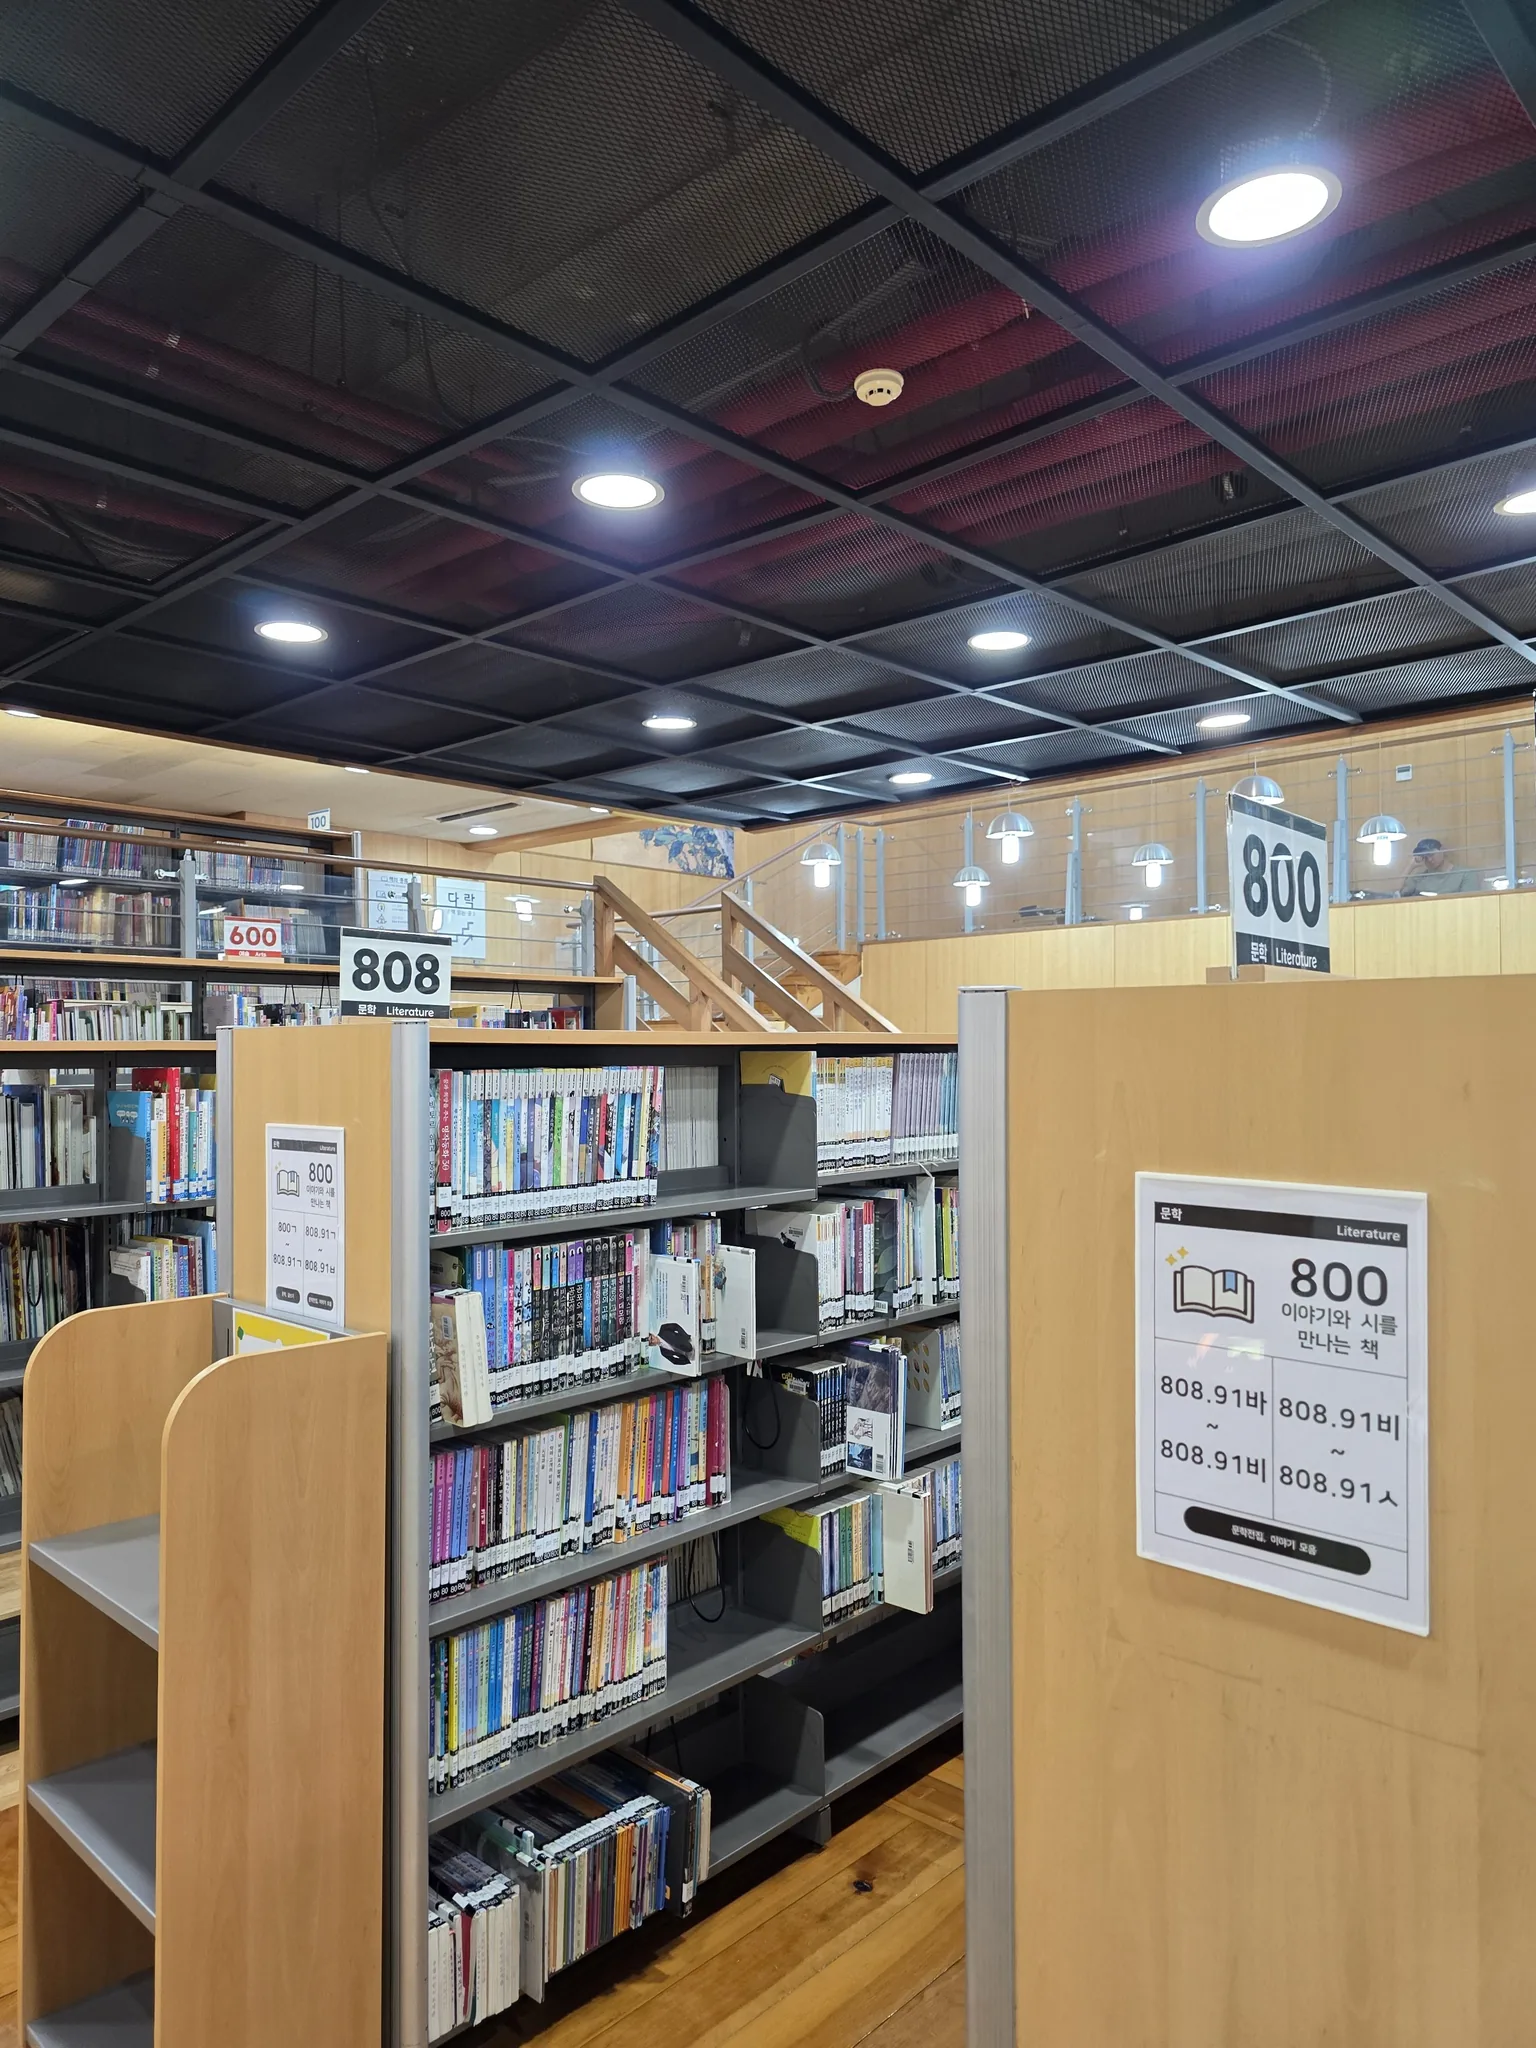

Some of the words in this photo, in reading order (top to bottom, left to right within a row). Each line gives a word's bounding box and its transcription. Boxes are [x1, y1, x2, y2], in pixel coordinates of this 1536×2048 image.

[311, 815, 326, 829] 100
[1243, 834, 1320, 928] 800
[229, 926, 276, 946] 600
[352, 948, 440, 995] 808
[1251, 942, 1267, 963] 문학
[1276, 947, 1317, 969] Literature
[358, 1004, 376, 1015] 문학
[386, 1006, 435, 1017] Literature
[442, 1126, 450, 1158] 명작동화
[309, 1162, 333, 1184] 800
[1160, 1207, 1183, 1221] 문학
[1337, 1225, 1401, 1241] Literature
[1290, 1258, 1388, 1306] 800
[1281, 1303, 1351, 1329] 이야기와
[1361, 1313, 1398, 1336] 시를
[1298, 1330, 1351, 1355] 만나는
[1360, 1338, 1379, 1360] 책
[1160, 1375, 1268, 1416] 808.91바
[1279, 1397, 1400, 1441] 808.91비
[1160, 1439, 1266, 1483] 808.91비
[1231, 1524, 1266, 1543] 문학전집,
[1270, 1534, 1296, 1551] 이야기
[1299, 1542, 1318, 1556] 모음
